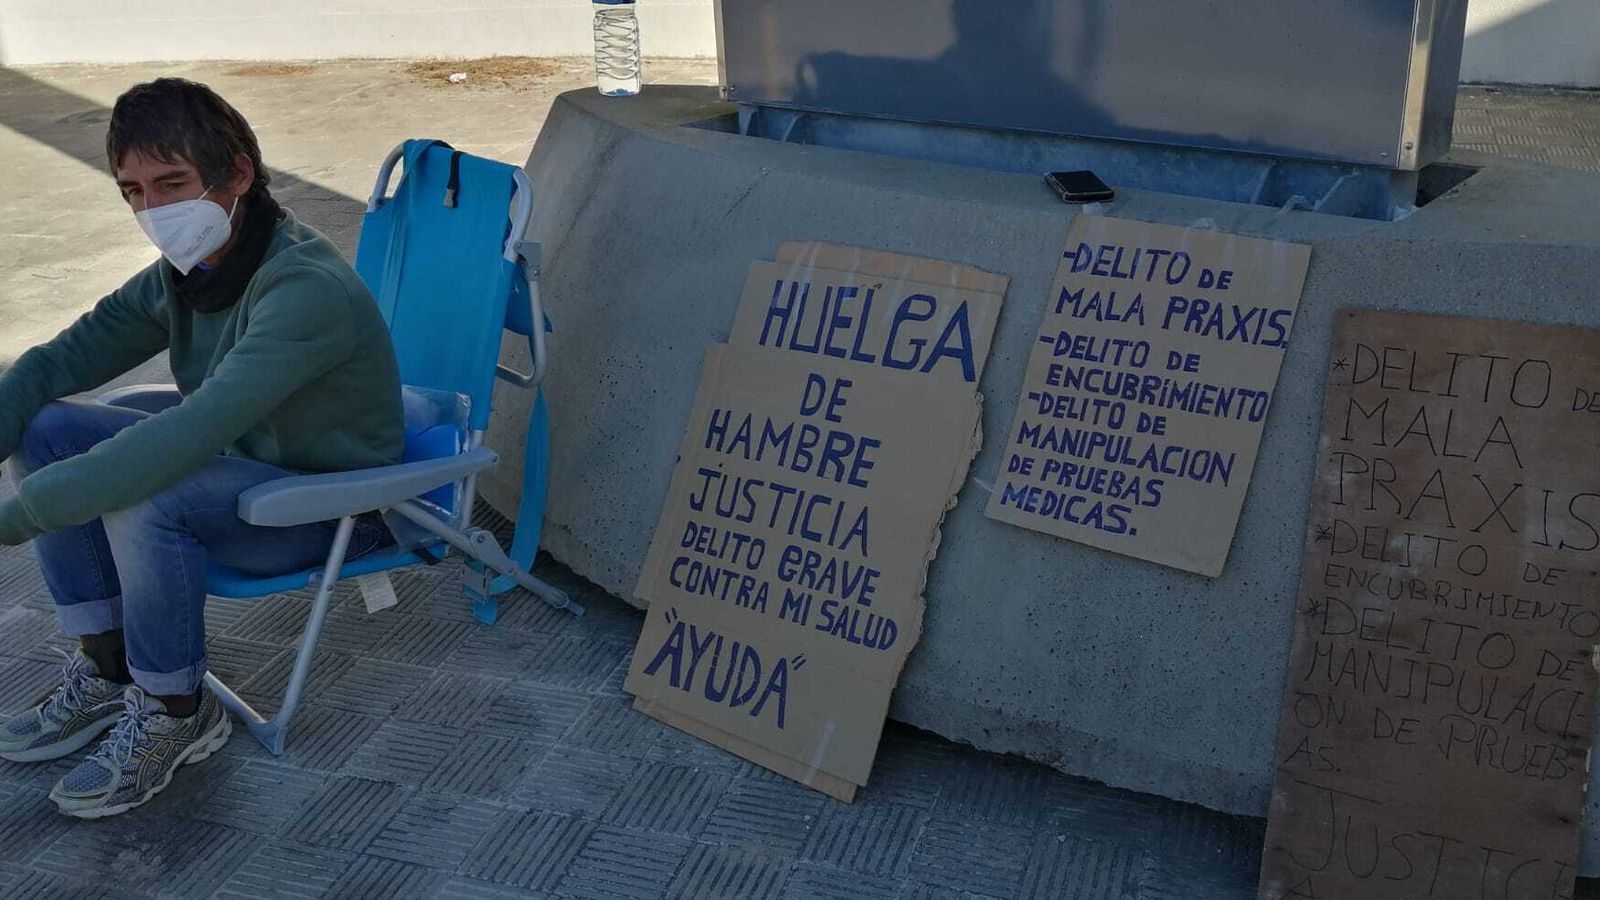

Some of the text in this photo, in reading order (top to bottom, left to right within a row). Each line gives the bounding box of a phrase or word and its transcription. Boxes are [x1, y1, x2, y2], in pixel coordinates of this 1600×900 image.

[1055, 286, 1145, 326] MALA
[1197, 268, 1234, 290] DE
[759, 279, 976, 382] HUELGA
[1166, 350, 1201, 373] DE
[800, 372, 853, 422] DE
[1136, 411, 1167, 436] DE
[1572, 387, 1600, 413] DE
[704, 408, 881, 488] HAMBRE
[1016, 420, 1236, 487] MANIPULACION
[1340, 397, 1524, 469] MALA
[1007, 454, 1165, 508] DE PRUEBAS
[1332, 451, 1600, 551] PRAXIS
[690, 463, 869, 557] JUSTICIA
[1000, 481, 1138, 536] MEDICAS.
[681, 521, 881, 607] DELITO GRAVE
[1523, 562, 1567, 586] DE
[669, 556, 898, 651] CONTRA MI SALUD
[1324, 563, 1600, 638] ENCUBRIMIENTO
[1536, 649, 1585, 681] DE
[1294, 691, 1347, 728] ON
[1373, 707, 1421, 745] DE
